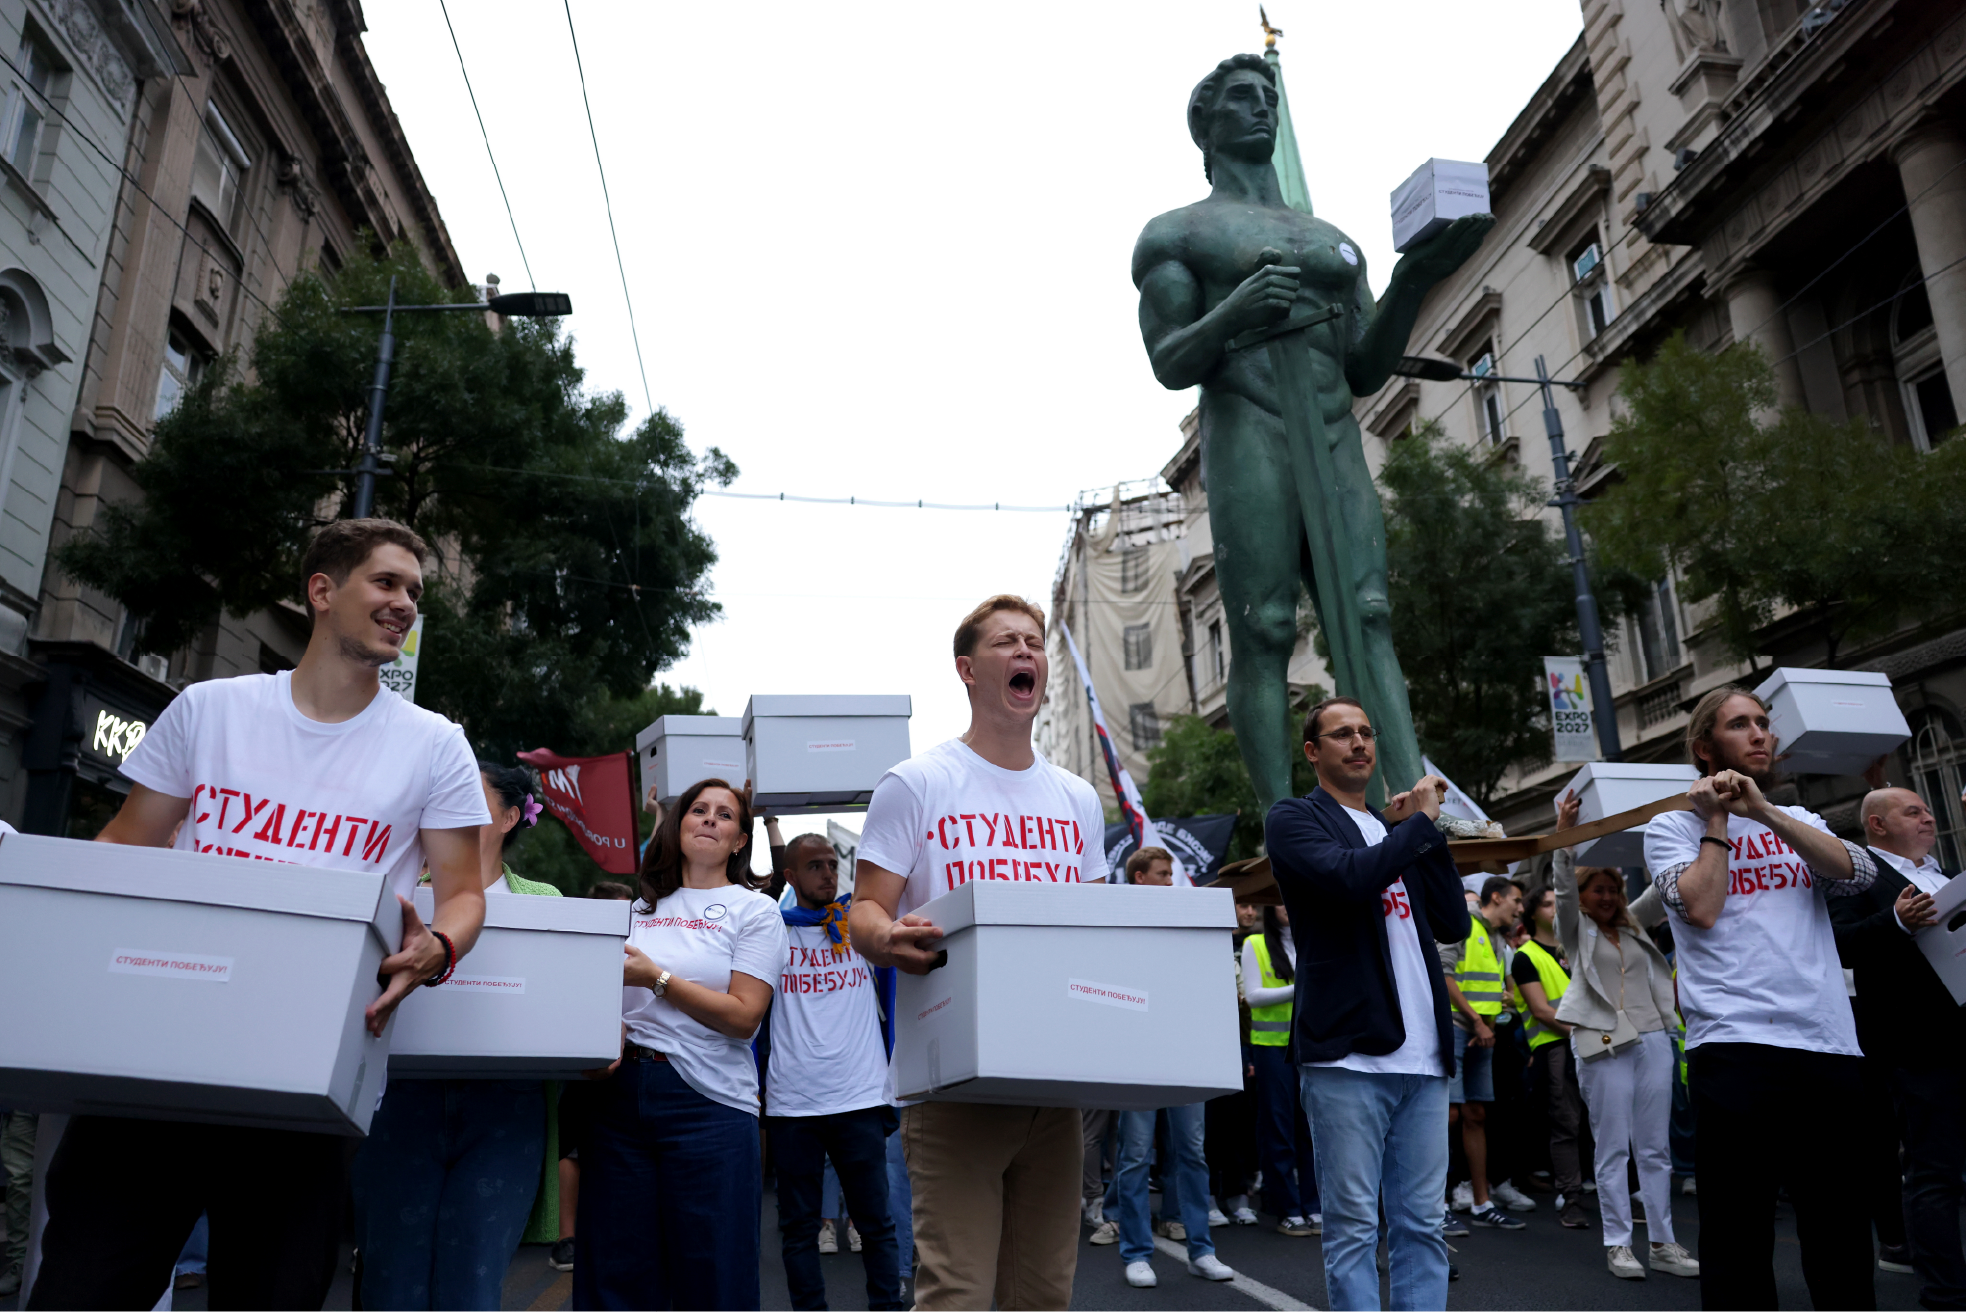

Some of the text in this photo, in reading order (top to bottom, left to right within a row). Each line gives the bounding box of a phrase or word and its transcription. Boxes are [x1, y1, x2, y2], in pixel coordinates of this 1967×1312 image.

[380, 668, 413, 681] XPO
[1555, 711, 1588, 722] EXPO
[1556, 722, 1589, 733] 2027
[193, 783, 393, 864] СТУДЕНТИ
[116, 955, 228, 974] СТУДЕНТИ ПОБЕЂУЈУ!
[445, 979, 481, 987] СТУДЕНТИ
[1070, 984, 1146, 1005] СТУДЕНТИ ПОБЕЂУЈУ!
